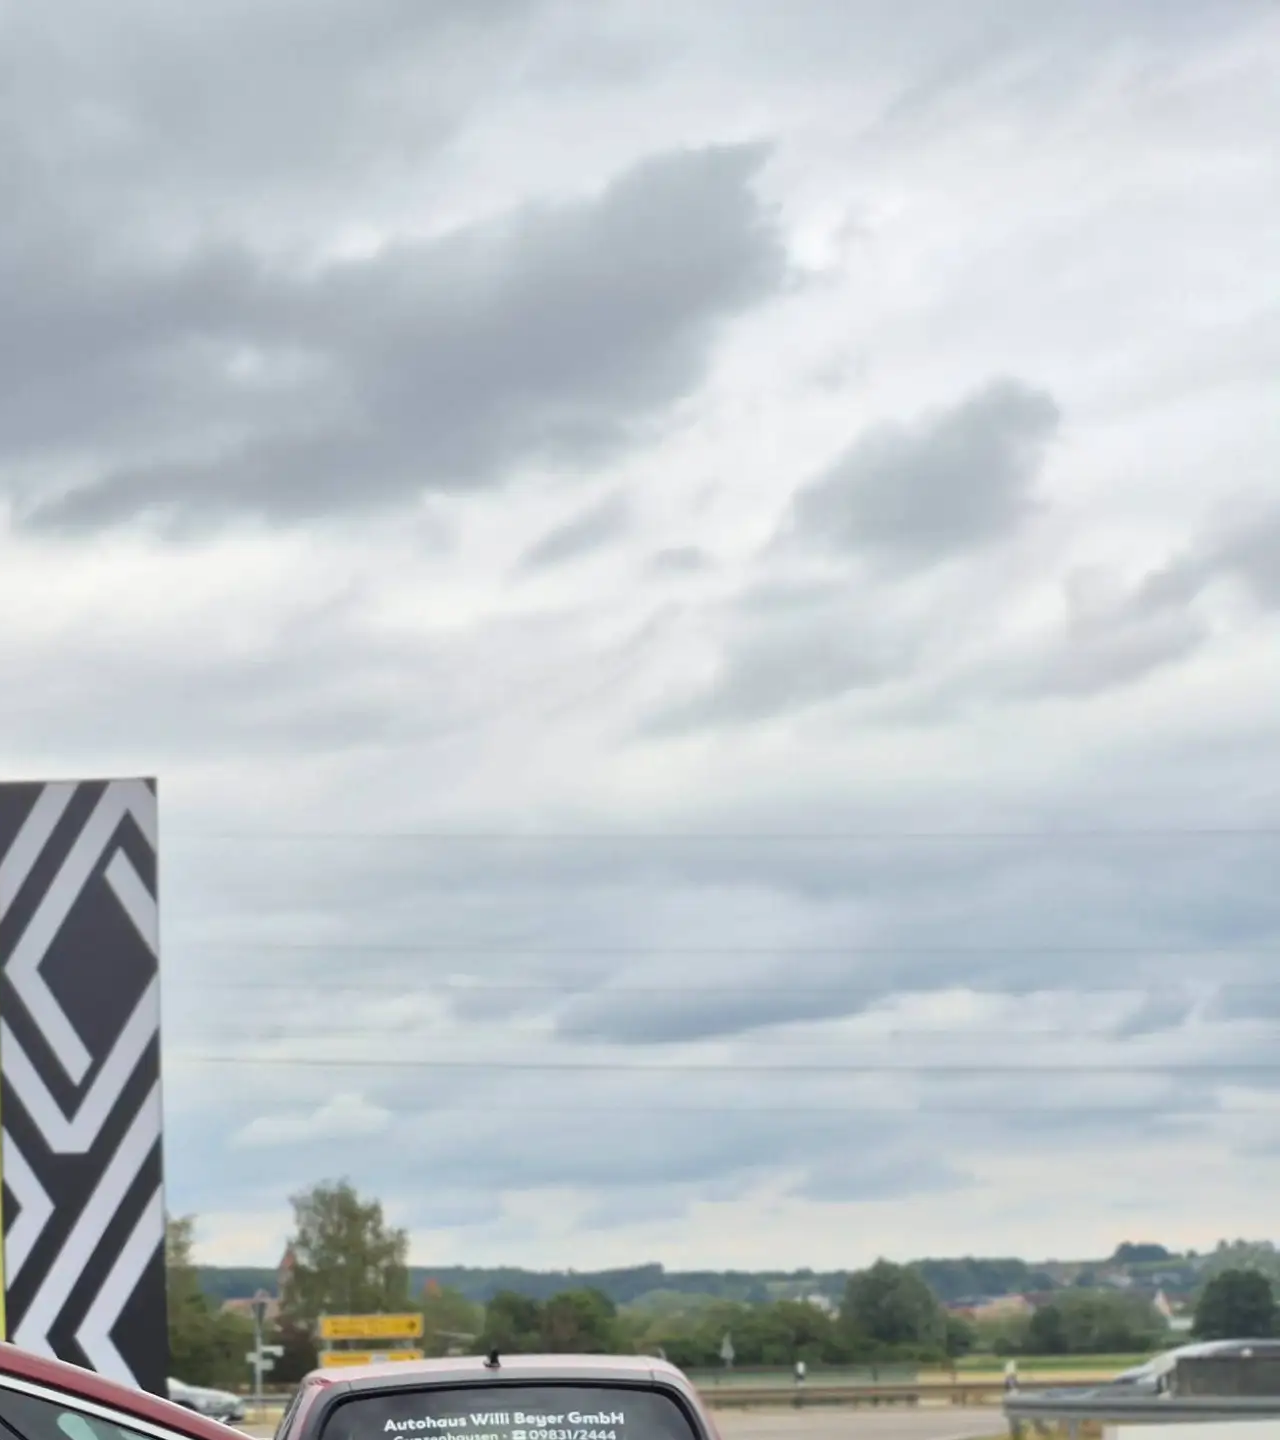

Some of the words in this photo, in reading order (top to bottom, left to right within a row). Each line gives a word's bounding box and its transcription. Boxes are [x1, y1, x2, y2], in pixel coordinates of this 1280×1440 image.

[383, 1416, 467, 1432] Autohaus
[470, 1413, 510, 1426] Willi
[513, 1412, 563, 1427] Beyer
[567, 1411, 624, 1425] GmbH
